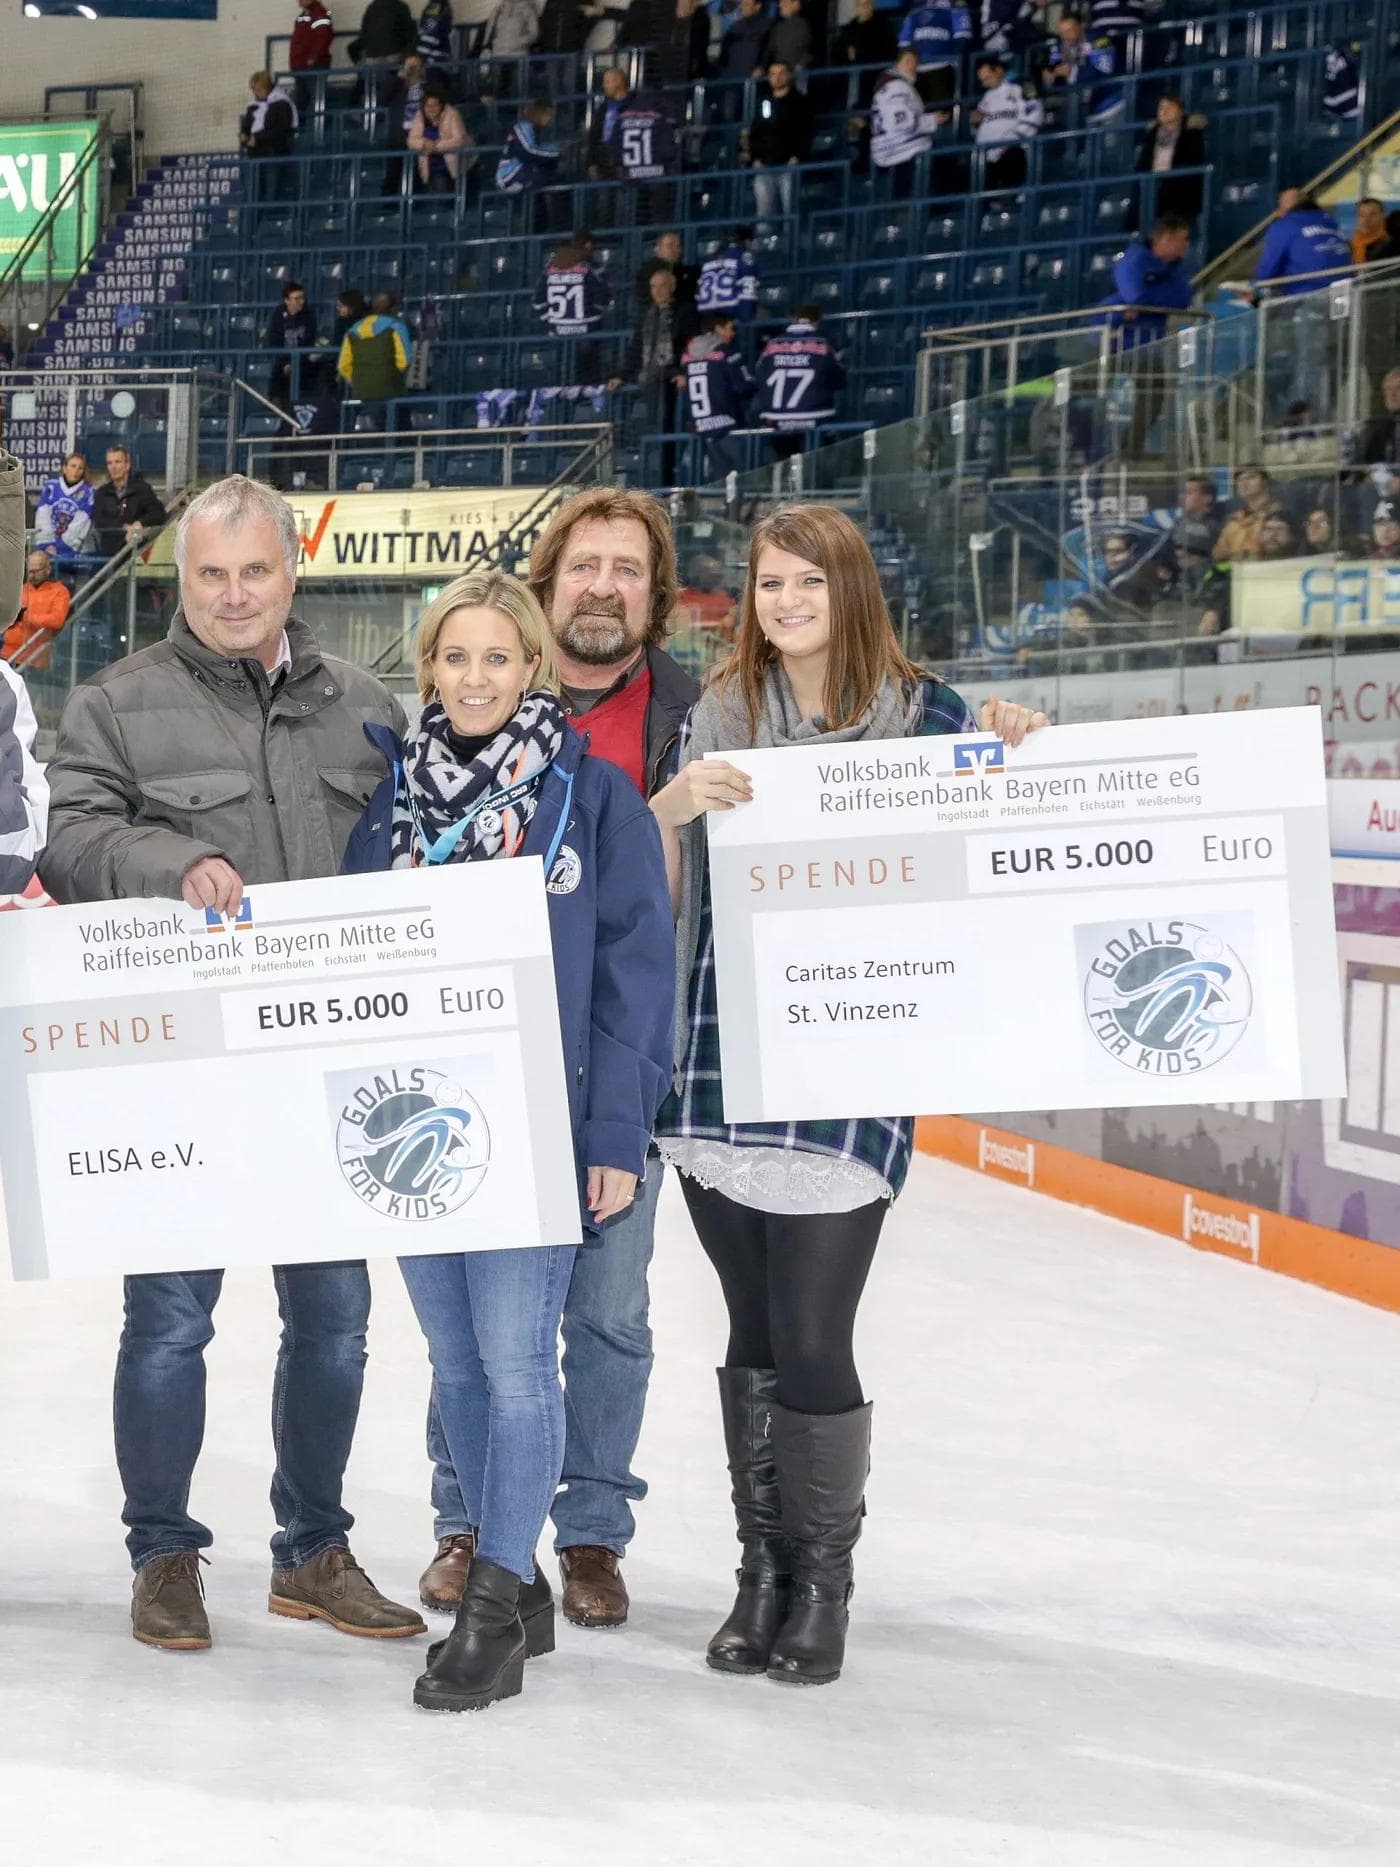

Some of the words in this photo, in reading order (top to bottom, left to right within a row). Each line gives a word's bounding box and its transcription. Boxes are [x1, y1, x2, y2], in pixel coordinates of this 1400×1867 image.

[623, 128, 652, 167] 51
[547, 285, 584, 319] 51
[766, 368, 815, 409] 17
[818, 756, 931, 784] Volksbank
[819, 781, 993, 813] Raiffeisenbank
[1005, 775, 1087, 802] Bayern
[1097, 769, 1157, 793] Mitte
[1169, 764, 1200, 787] eG
[937, 807, 989, 823] Ingolstadt
[1000, 803, 1068, 817] Pfaffenhofen
[1080, 799, 1125, 812] Eichstätt
[1136, 793, 1202, 808] Weißenburg
[750, 855, 916, 892] SPENDE
[991, 847, 1054, 876] EUR
[1065, 838, 1153, 870] 5.000
[1202, 834, 1272, 863] Euro
[80, 914, 185, 944] Volksbank
[82, 937, 243, 972] Raiffeisenbank
[255, 930, 330, 957] Bayern
[340, 923, 396, 947] Mitte
[405, 919, 434, 942] eG
[193, 964, 241, 979] Ingolstadt
[251, 958, 314, 972] Pfaffenhofen
[324, 953, 366, 967] Eichstätt
[377, 946, 437, 962] Weißenburg
[1090, 920, 1184, 979] GOALS
[785, 961, 857, 983] Caritas
[864, 957, 955, 980] Zentrum
[258, 1001, 317, 1030] EUR
[326, 992, 409, 1023] 5.000
[439, 987, 504, 1015] Euro
[788, 1003, 817, 1024] St.
[825, 1000, 918, 1022] Vinzenz
[22, 1013, 178, 1053] SPENDE
[1089, 1009, 1132, 1056] FOR
[1136, 1047, 1203, 1074] KIDS
[341, 1067, 425, 1127] GOALS
[68, 1147, 142, 1176] ELISA
[151, 1143, 204, 1170] e.V.
[342, 1156, 381, 1203] FOR
[387, 1193, 448, 1219] KIDS
